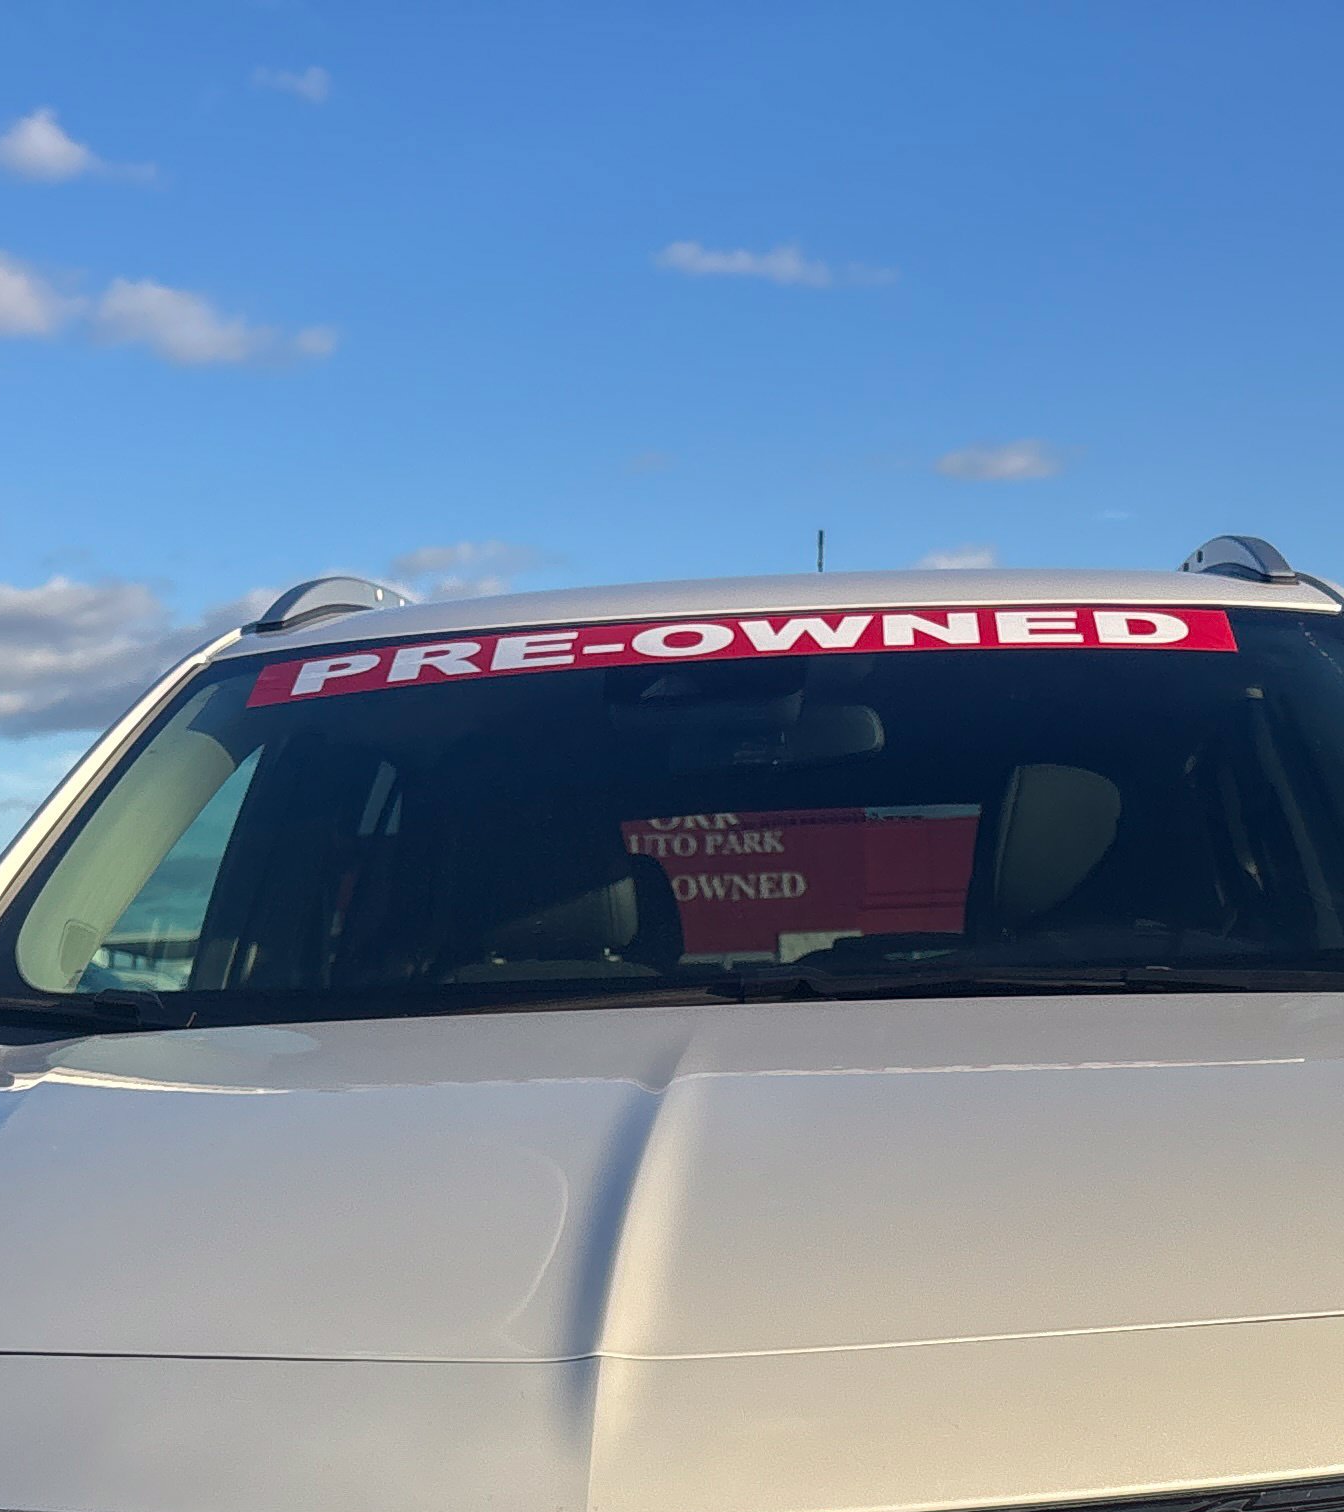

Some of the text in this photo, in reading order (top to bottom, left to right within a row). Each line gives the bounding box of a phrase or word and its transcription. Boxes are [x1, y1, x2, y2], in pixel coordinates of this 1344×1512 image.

[289, 610, 1190, 696] PRE-OWNED
[628, 831, 784, 857] UTO PARK
